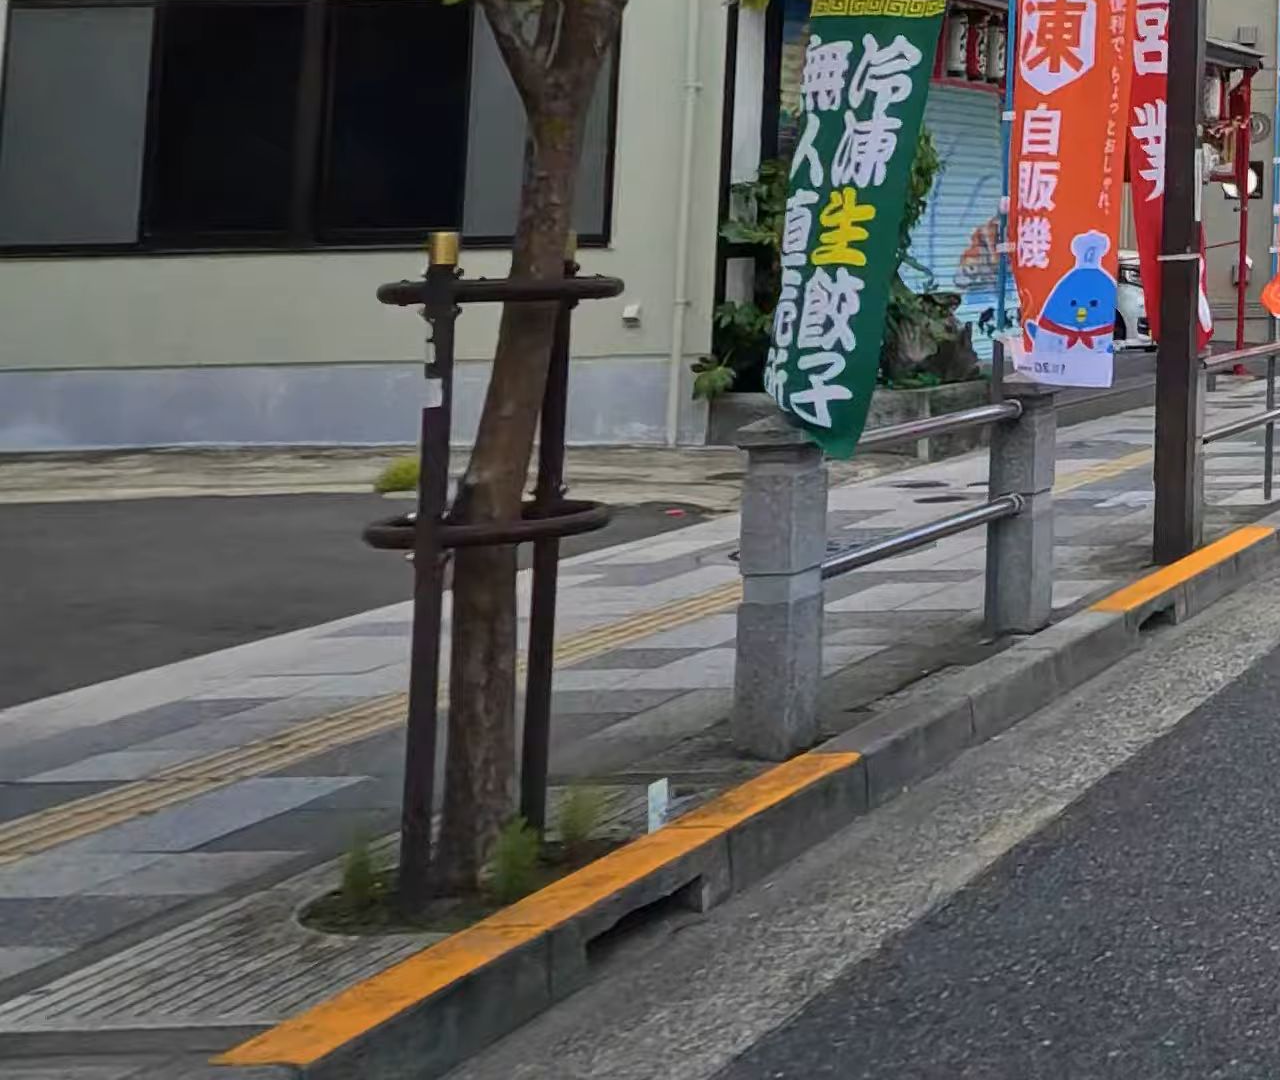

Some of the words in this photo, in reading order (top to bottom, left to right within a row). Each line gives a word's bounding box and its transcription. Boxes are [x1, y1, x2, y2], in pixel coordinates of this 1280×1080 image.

[788, 32, 923, 429] 冷凍生餃子
